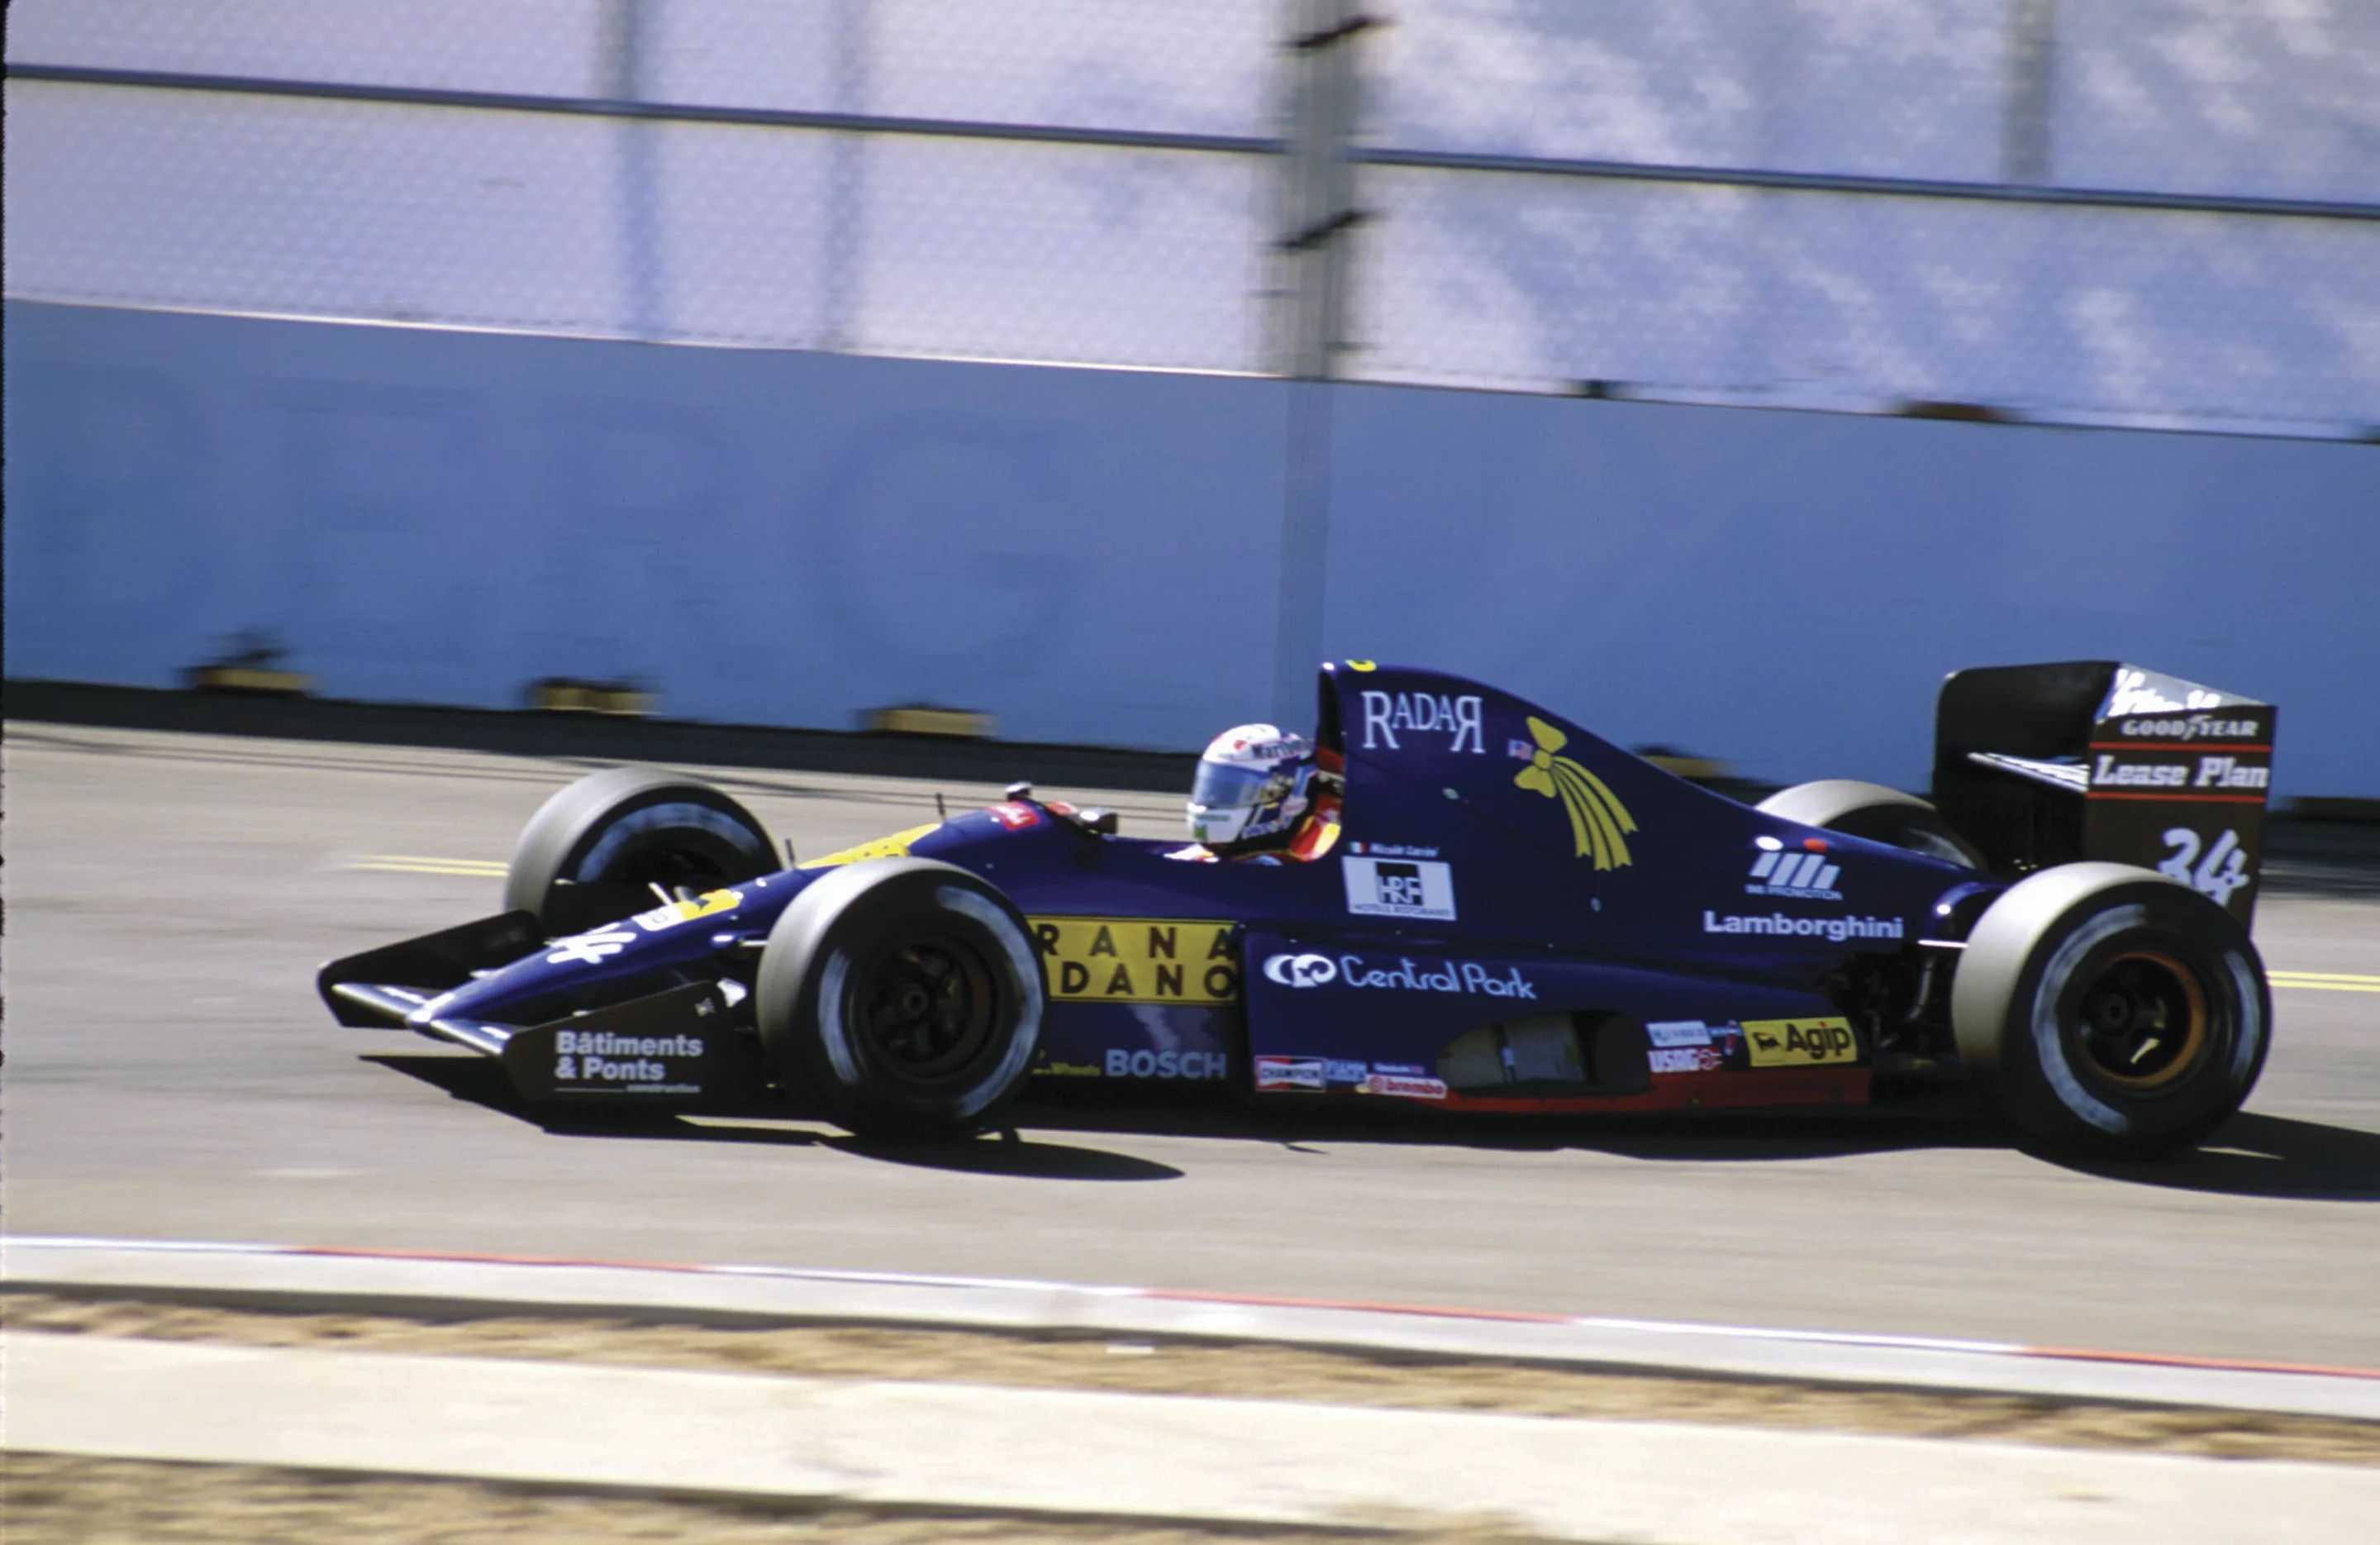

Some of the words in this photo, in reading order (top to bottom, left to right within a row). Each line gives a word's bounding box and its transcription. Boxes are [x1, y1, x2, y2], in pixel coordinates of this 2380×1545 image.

[1359, 690, 1487, 754] RADAR
[2121, 714, 2259, 741] GOODYEAR
[2092, 754, 2190, 786] Lease
[2192, 756, 2270, 789] Plan
[1703, 910, 1905, 942] Lamborghini
[1340, 955, 1461, 993] Central
[1461, 962, 1538, 1000] Park
[555, 1030, 704, 1057] Bâtiments
[1785, 1022, 1851, 1060] Agip
[554, 1056, 577, 1080] &
[581, 1056, 666, 1080] Ponts
[1105, 1049, 1227, 1080] BOSCH
